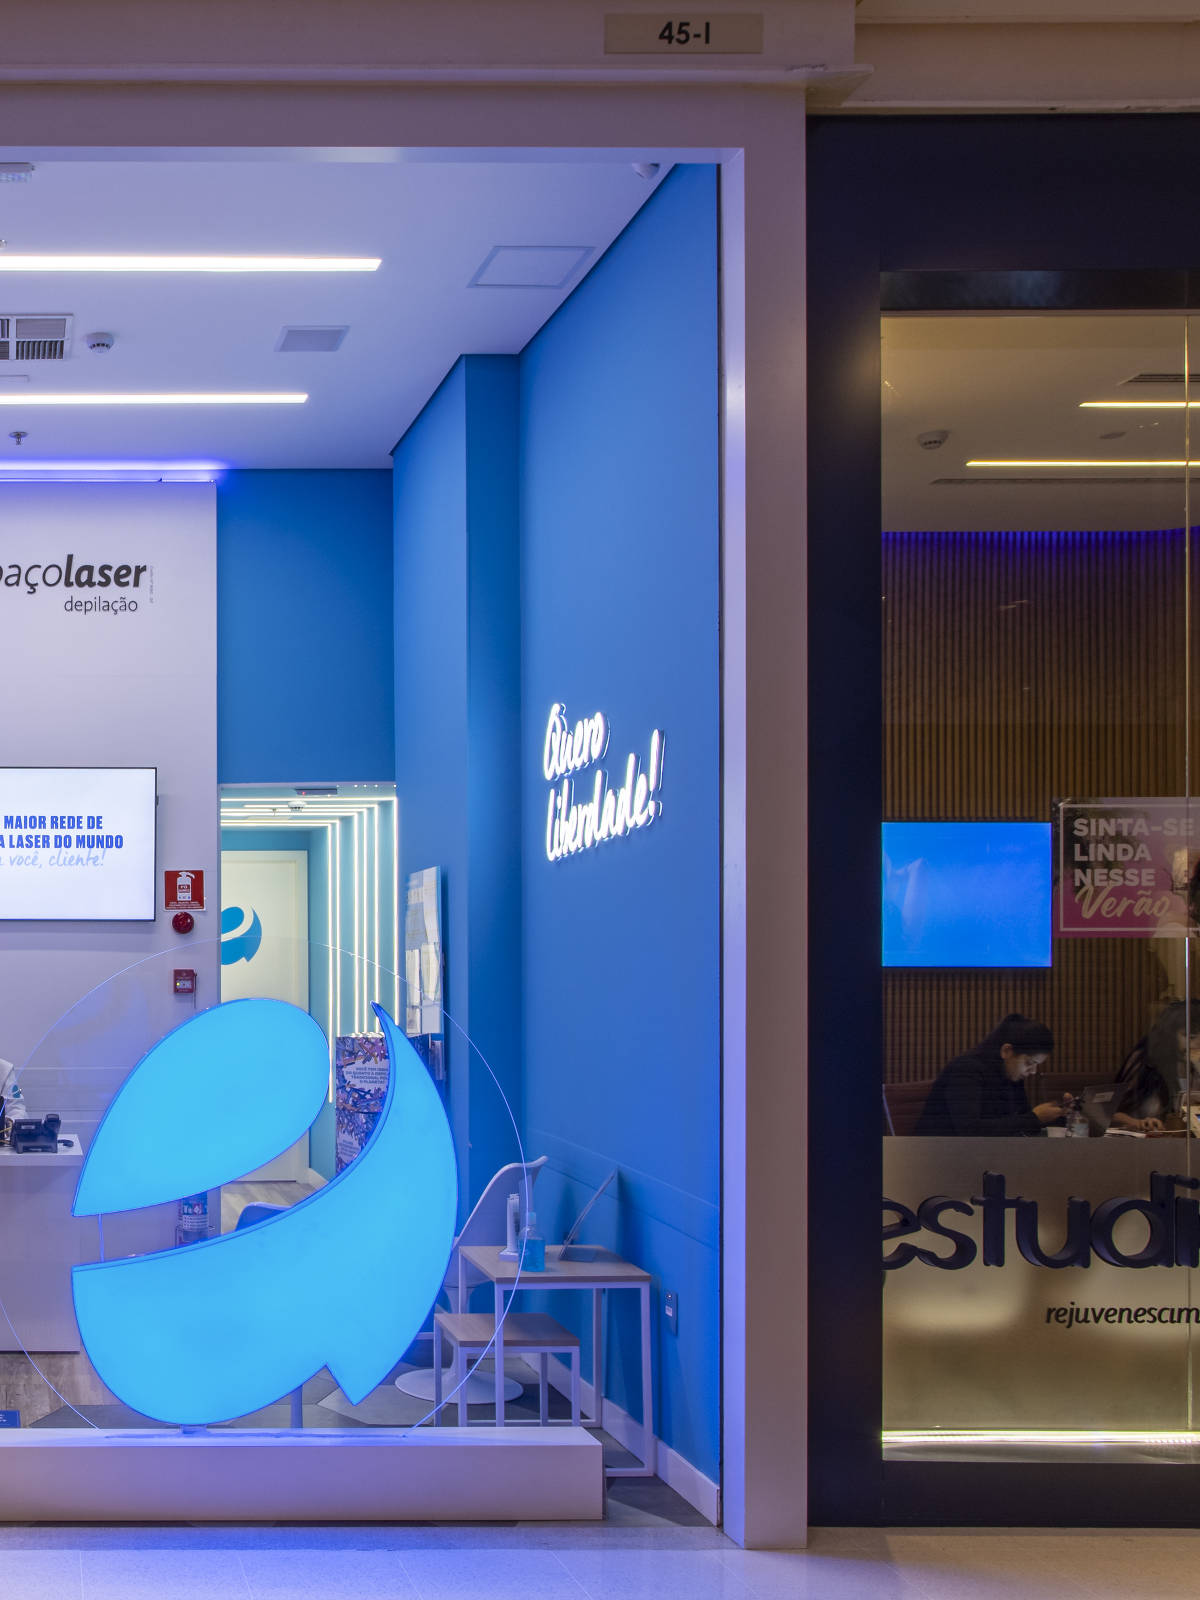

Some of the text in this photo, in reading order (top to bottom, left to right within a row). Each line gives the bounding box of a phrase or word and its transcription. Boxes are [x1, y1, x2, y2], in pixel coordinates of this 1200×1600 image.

[658, 21, 711, 45] 45-I
[63, 595, 139, 615] depilação
[3, 815, 47, 830] MAIOR
[50, 815, 83, 830] REDE
[86, 815, 103, 830] DE
[1072, 818, 1195, 837] SINTA-SE
[8, 834, 51, 849] LASER
[53, 834, 73, 849] DO
[75, 834, 124, 849] MUNDO
[9, 851, 42, 869] você,
[48, 848, 106, 868] cliente!
[1074, 843, 1153, 862] LINDA
[1074, 868, 1156, 887] NESSE
[1074, 881, 1171, 919] Verão
